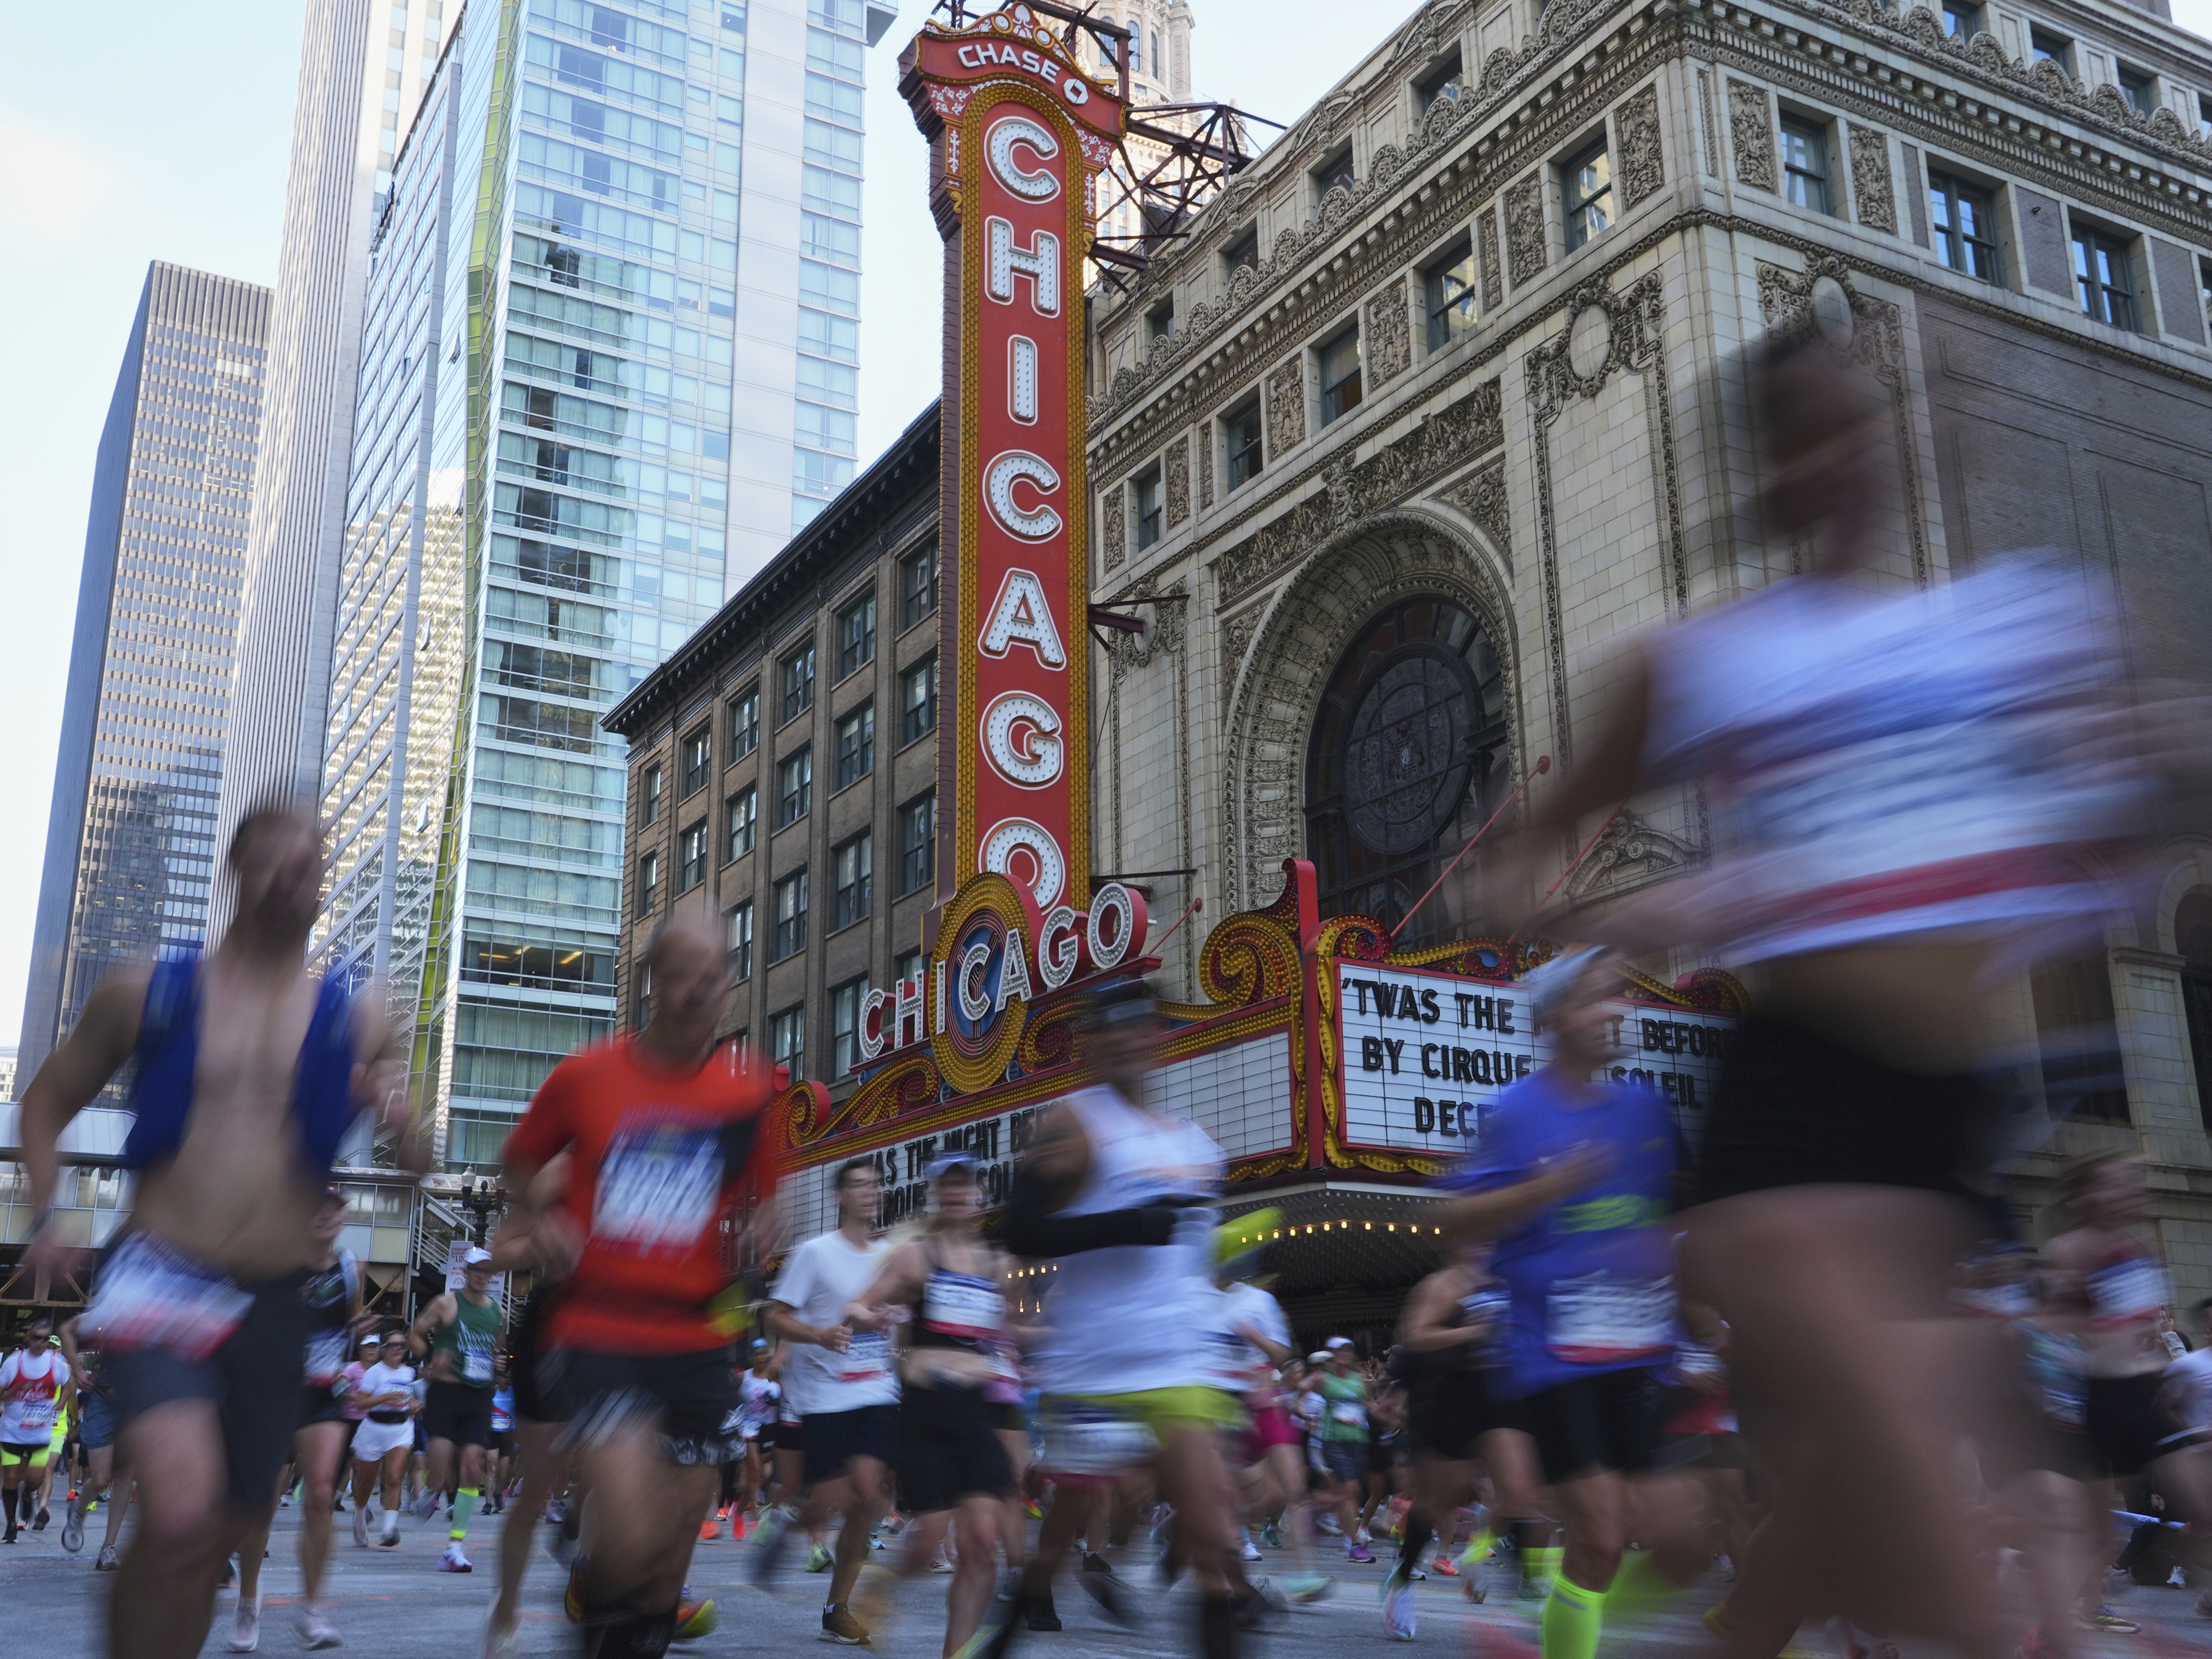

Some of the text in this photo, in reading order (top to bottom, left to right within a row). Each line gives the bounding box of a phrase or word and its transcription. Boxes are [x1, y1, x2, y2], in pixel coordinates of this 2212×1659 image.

[958, 44, 1061, 83] CHASE
[978, 116, 1067, 915] CHICAGO
[859, 882, 1133, 1058] CHICAGO
[1341, 978, 1440, 1023] 'TWAS
[1454, 992, 1515, 1034] THE
[1362, 1035, 1405, 1074] BY
[1422, 1043, 1532, 1085] CIRQUE
[1415, 1097, 1495, 1138] DECE
